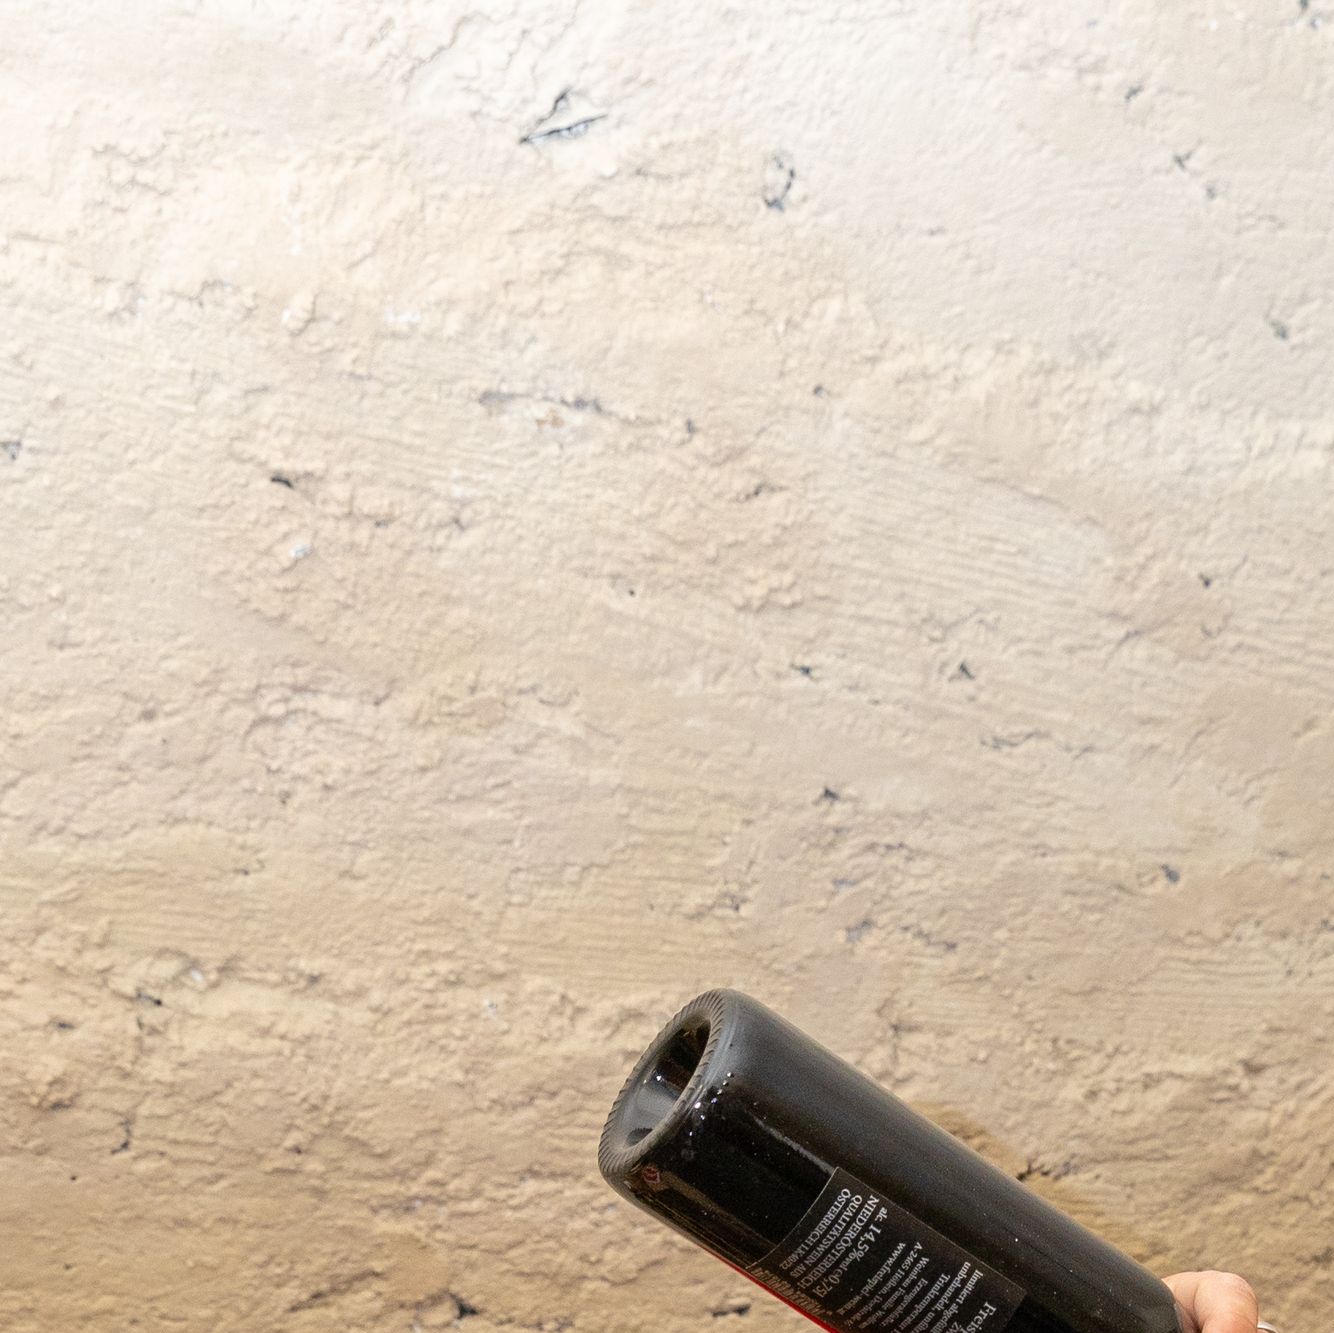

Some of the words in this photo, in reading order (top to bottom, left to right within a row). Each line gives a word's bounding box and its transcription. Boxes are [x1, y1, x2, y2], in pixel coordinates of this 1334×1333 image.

[795, 1192, 880, 1290] NIEDERÖSTERREICH
[802, 1191, 864, 1267] QUALITÄTSWEIN
[804, 1186, 853, 1247] ÖSTERREICH
[872, 1205, 890, 1225] alc.
[788, 1261, 807, 1279] AUS
[901, 1254, 930, 1290] Weinbau
[930, 1260, 973, 1315] unbehandelt,
[954, 1267, 985, 1305] limitiert
[897, 1270, 951, 1331] Trinktemperatur
